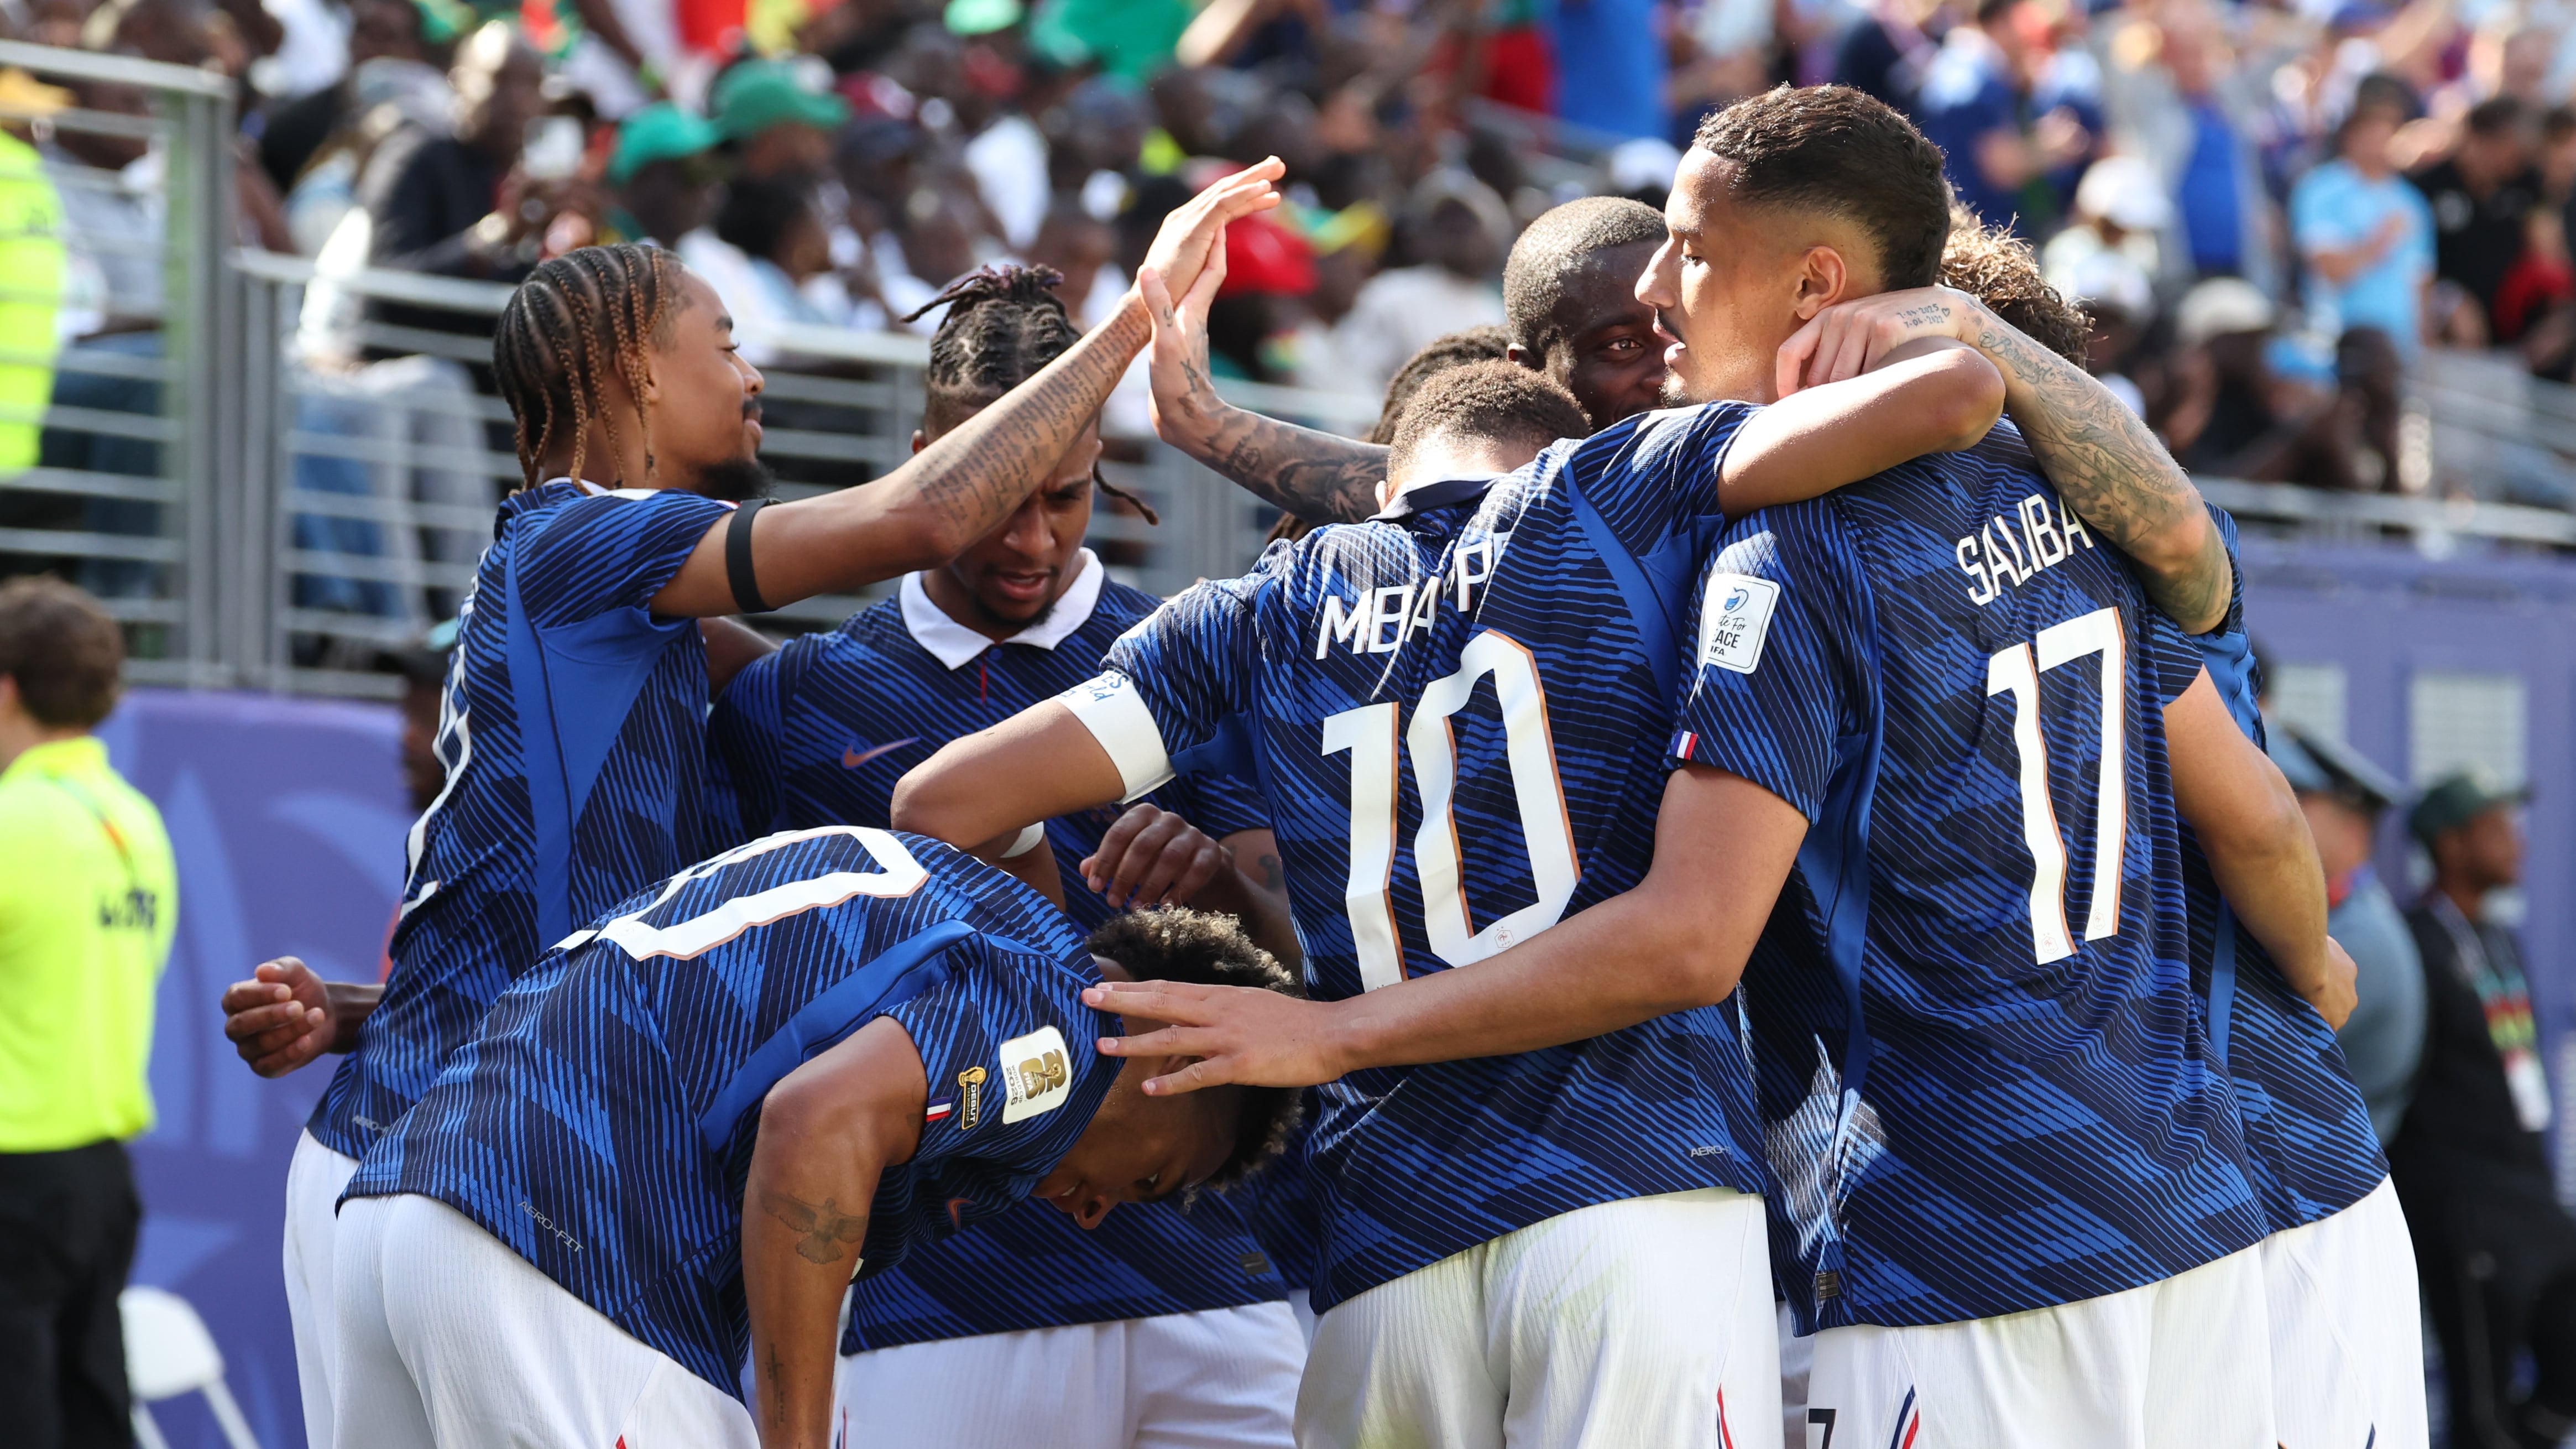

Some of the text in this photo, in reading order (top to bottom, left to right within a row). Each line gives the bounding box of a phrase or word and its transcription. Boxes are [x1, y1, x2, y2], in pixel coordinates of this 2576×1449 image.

[1956, 492, 2094, 606] SALIBA
[1316, 530, 1511, 660] MBAP
[1712, 628, 1741, 649] ACE
[1732, 617, 1747, 631] For
[1710, 645, 1725, 656] IFA
[1987, 606, 2126, 966] 17
[1321, 628, 1581, 993] 10
[1006, 1067, 1018, 1106] 2026
[1011, 1065, 1022, 1090] WORLD
[1023, 1071, 1034, 1091] FIFA
[518, 1201, 584, 1253] AERO-FIT
